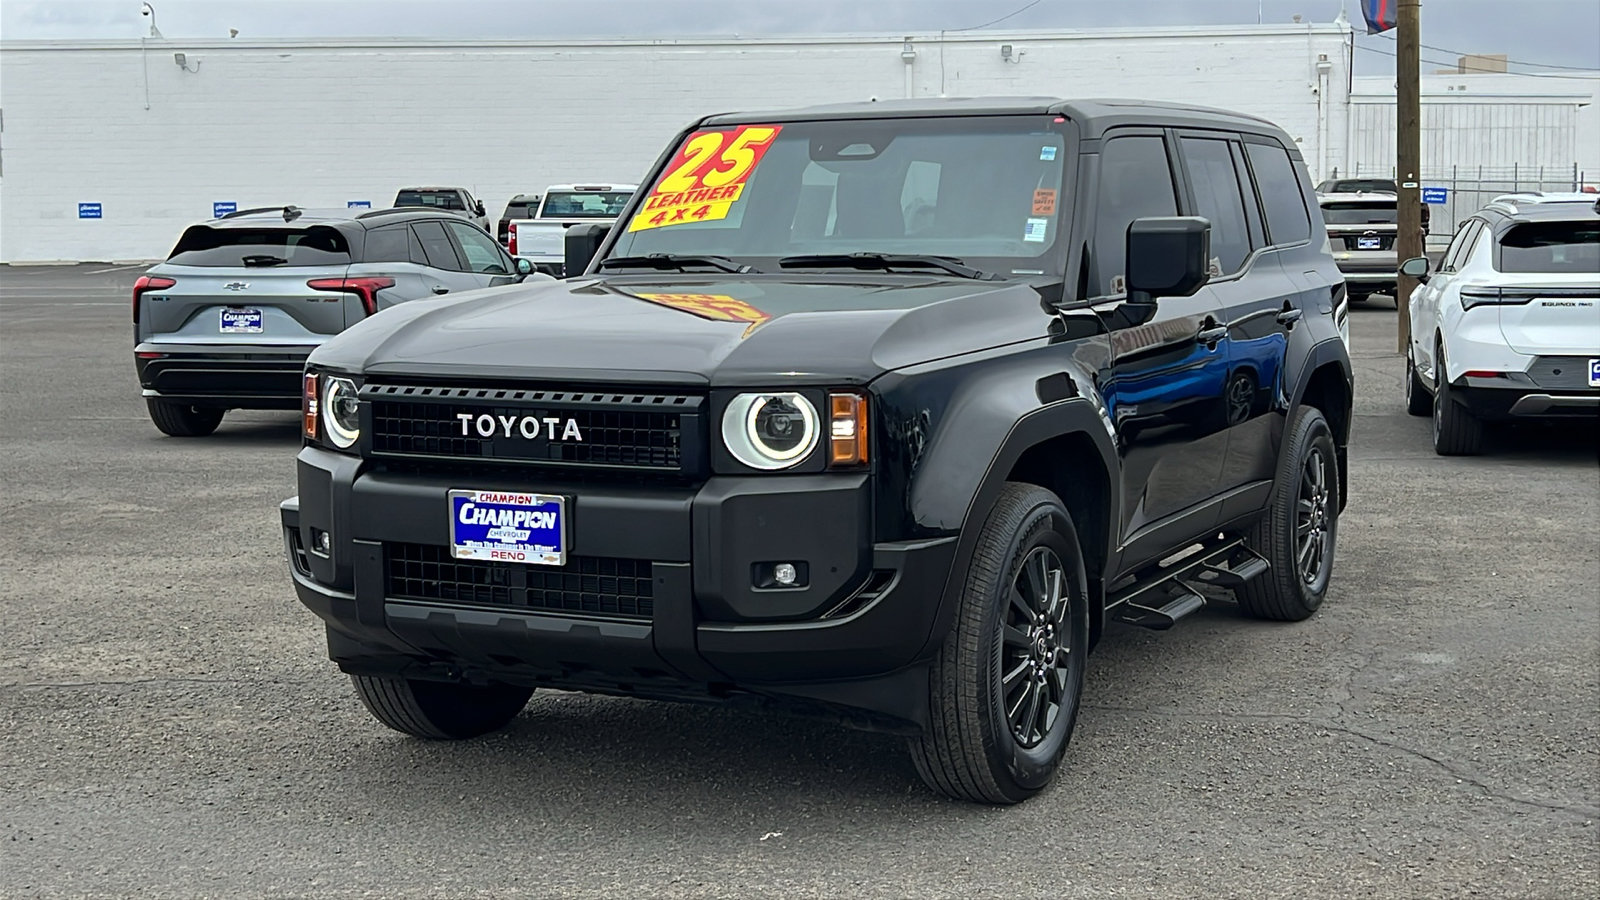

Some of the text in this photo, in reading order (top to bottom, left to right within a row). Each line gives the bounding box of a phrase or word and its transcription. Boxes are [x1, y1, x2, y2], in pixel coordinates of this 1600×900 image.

[656, 127, 775, 194] 25
[645, 184, 739, 211] LEATHER
[456, 413, 583, 441] TOYOTA
[479, 493, 533, 505] CHAMPION
[459, 502, 557, 530] CHAMPION
[489, 530, 528, 539] CHEVROLET
[490, 550, 526, 561] RENO
